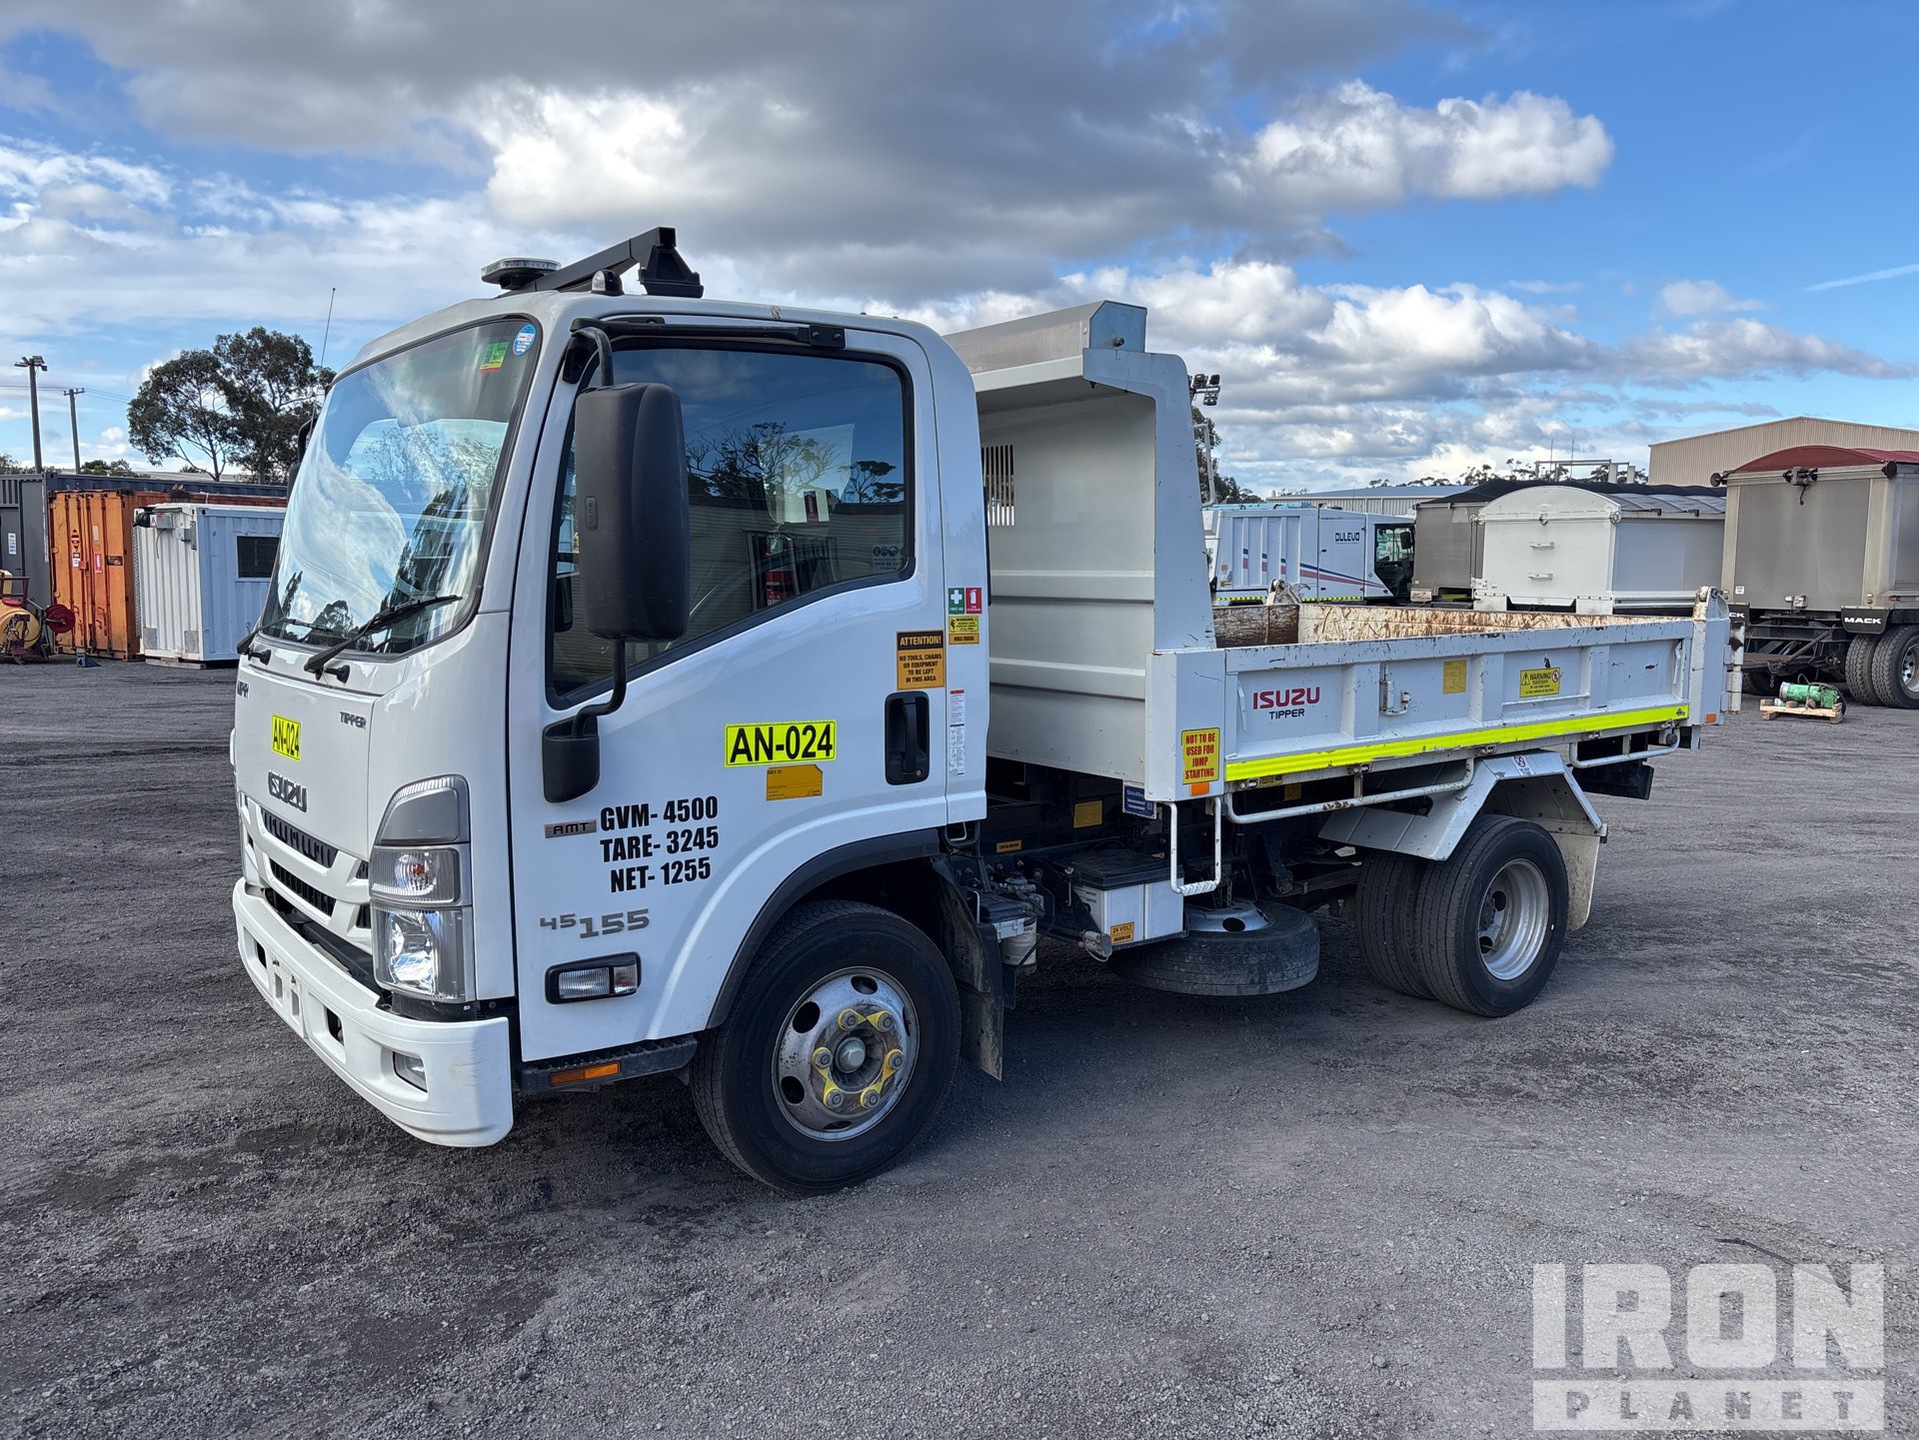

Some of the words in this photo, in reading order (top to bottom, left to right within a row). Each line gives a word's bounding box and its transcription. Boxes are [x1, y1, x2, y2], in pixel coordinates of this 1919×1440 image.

[1844, 617, 1881, 625] MACK
[1253, 687, 1320, 709] ISUZU
[339, 711, 367, 730] TIPPER
[1269, 708, 1305, 719] TIPPER
[273, 718, 299, 758] AN-024
[729, 723, 833, 763] AN-024
[1185, 734, 1198, 744] NOT
[1198, 733, 1207, 743] TO
[1207, 732, 1216, 742] BE
[1185, 745, 1202, 756] USED
[1203, 744, 1215, 754] FOR
[1192, 756, 1208, 767] JUMP
[1185, 767, 1215, 779] STARTING
[268, 770, 308, 813] ISUZU
[600, 803, 658, 832] GVM-
[663, 796, 718, 824] 4500
[553, 822, 589, 835] AMT
[600, 834, 661, 862] TARE-
[666, 826, 719, 854] 3245
[611, 865, 655, 893] NET-
[660, 856, 711, 885] 1255
[540, 913, 577, 930] 45
[580, 908, 650, 939] 155
